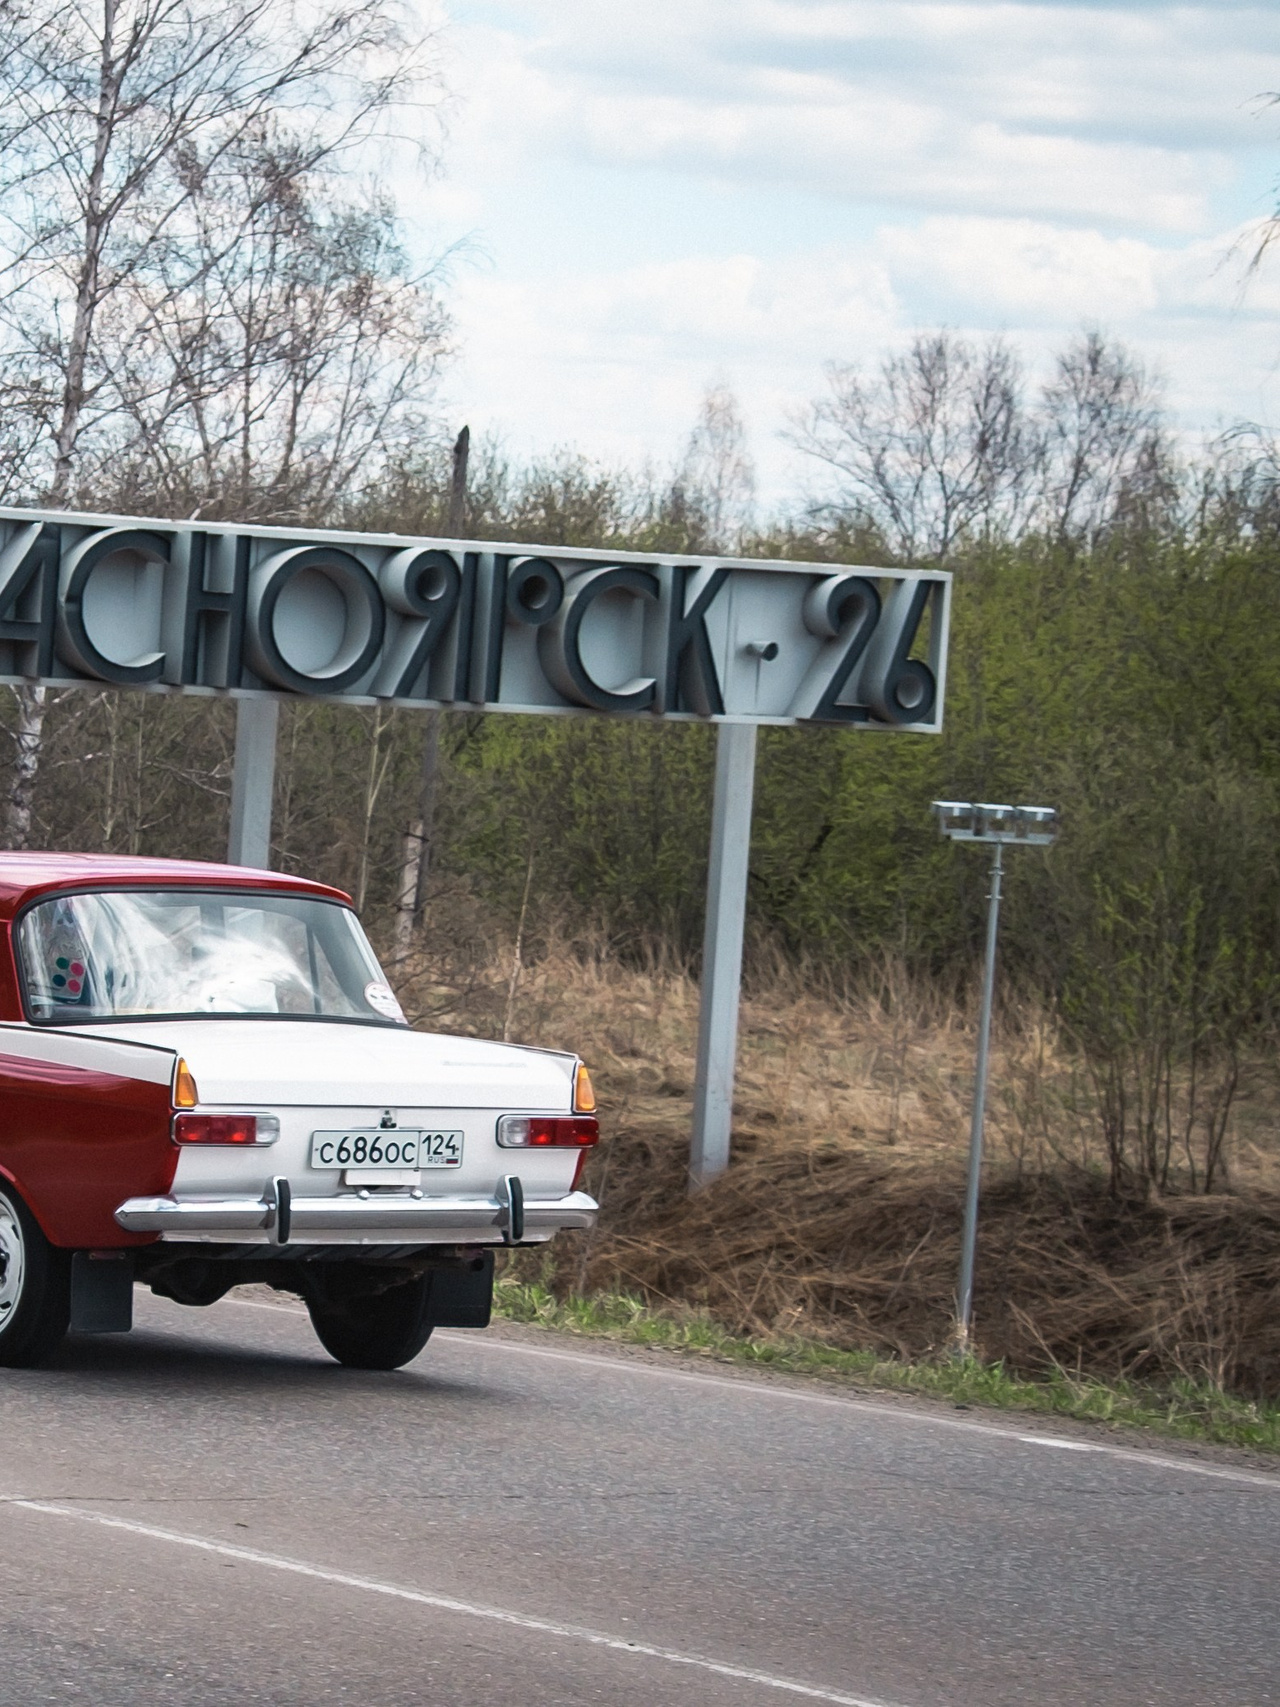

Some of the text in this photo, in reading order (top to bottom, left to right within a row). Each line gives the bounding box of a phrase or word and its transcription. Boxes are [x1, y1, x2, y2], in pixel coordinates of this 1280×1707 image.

[320, 1134, 458, 1164] С686ОС 124
[428, 1156, 445, 1164] RUS
